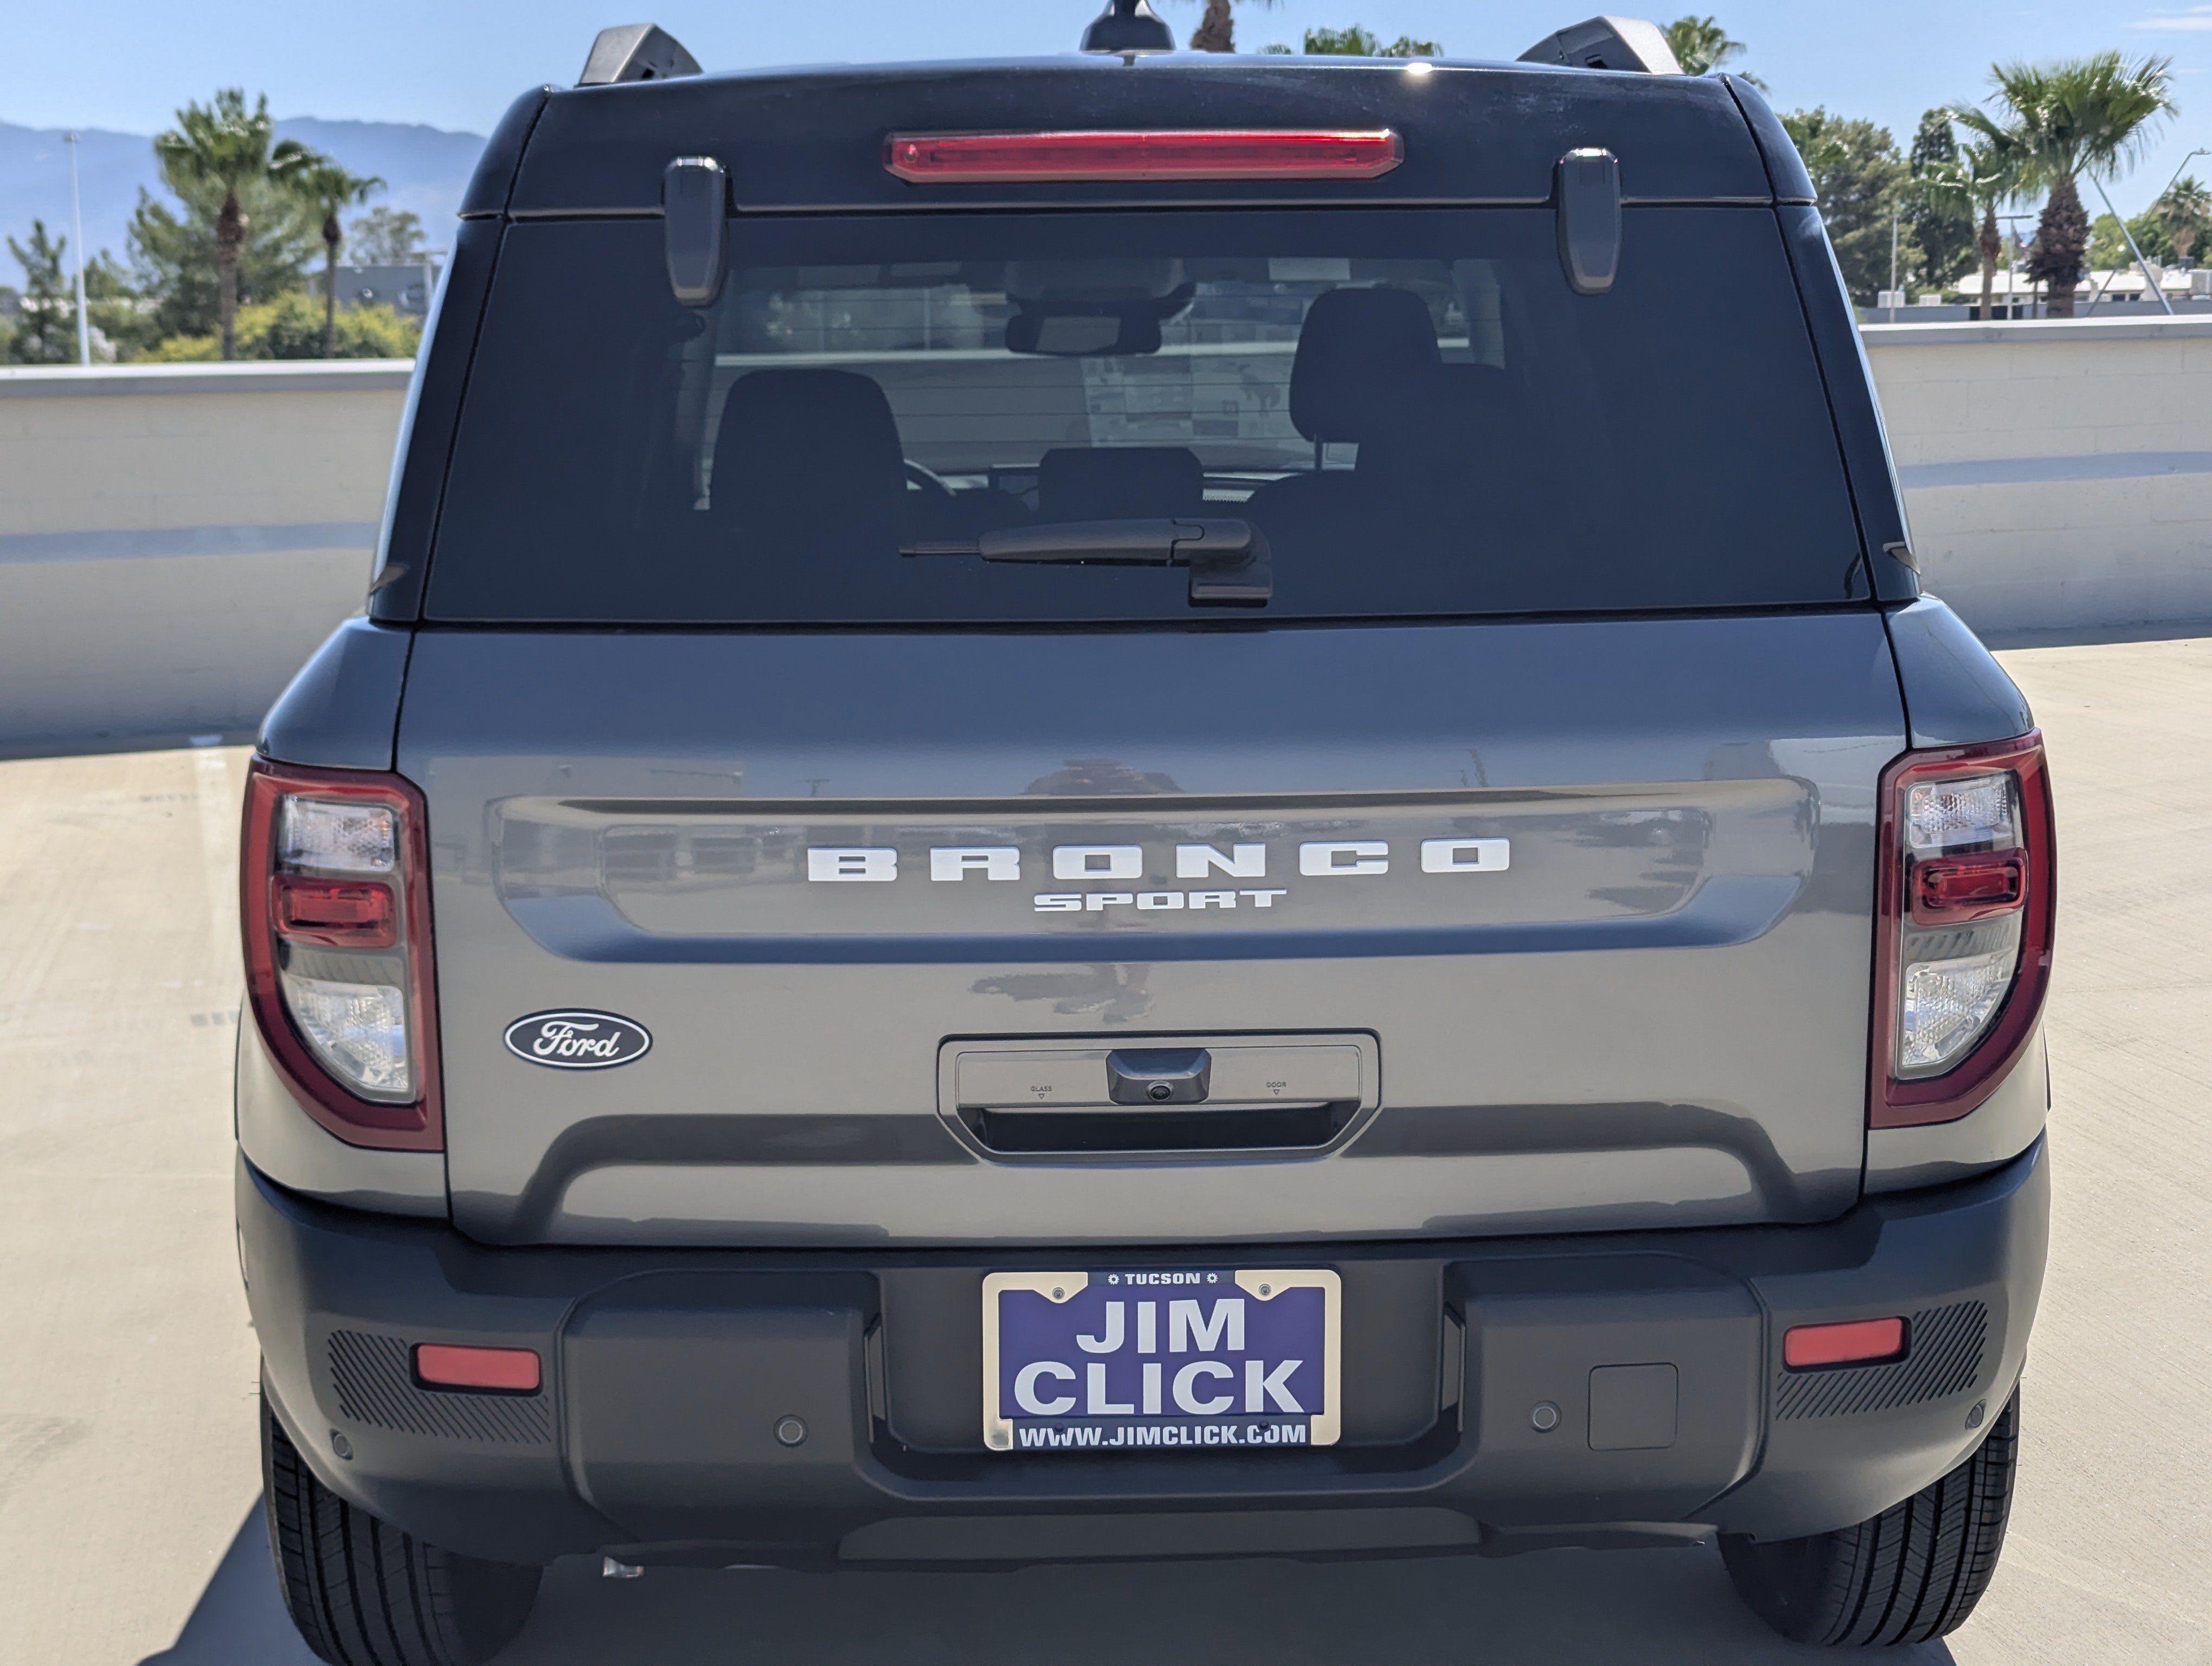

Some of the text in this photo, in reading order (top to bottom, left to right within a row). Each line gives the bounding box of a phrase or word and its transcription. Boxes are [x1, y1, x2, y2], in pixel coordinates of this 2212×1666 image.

[807, 837, 1510, 881] BRONCO
[1033, 888, 1287, 912] SPORT
[532, 1021, 621, 1057] Ford
[1125, 1272, 1200, 1285] TUCSON
[1076, 1298, 1245, 1354] JIM
[1014, 1360, 1304, 1415] CLICK
[1019, 1425, 1306, 1447] WWW.JIMCLICK.COM
